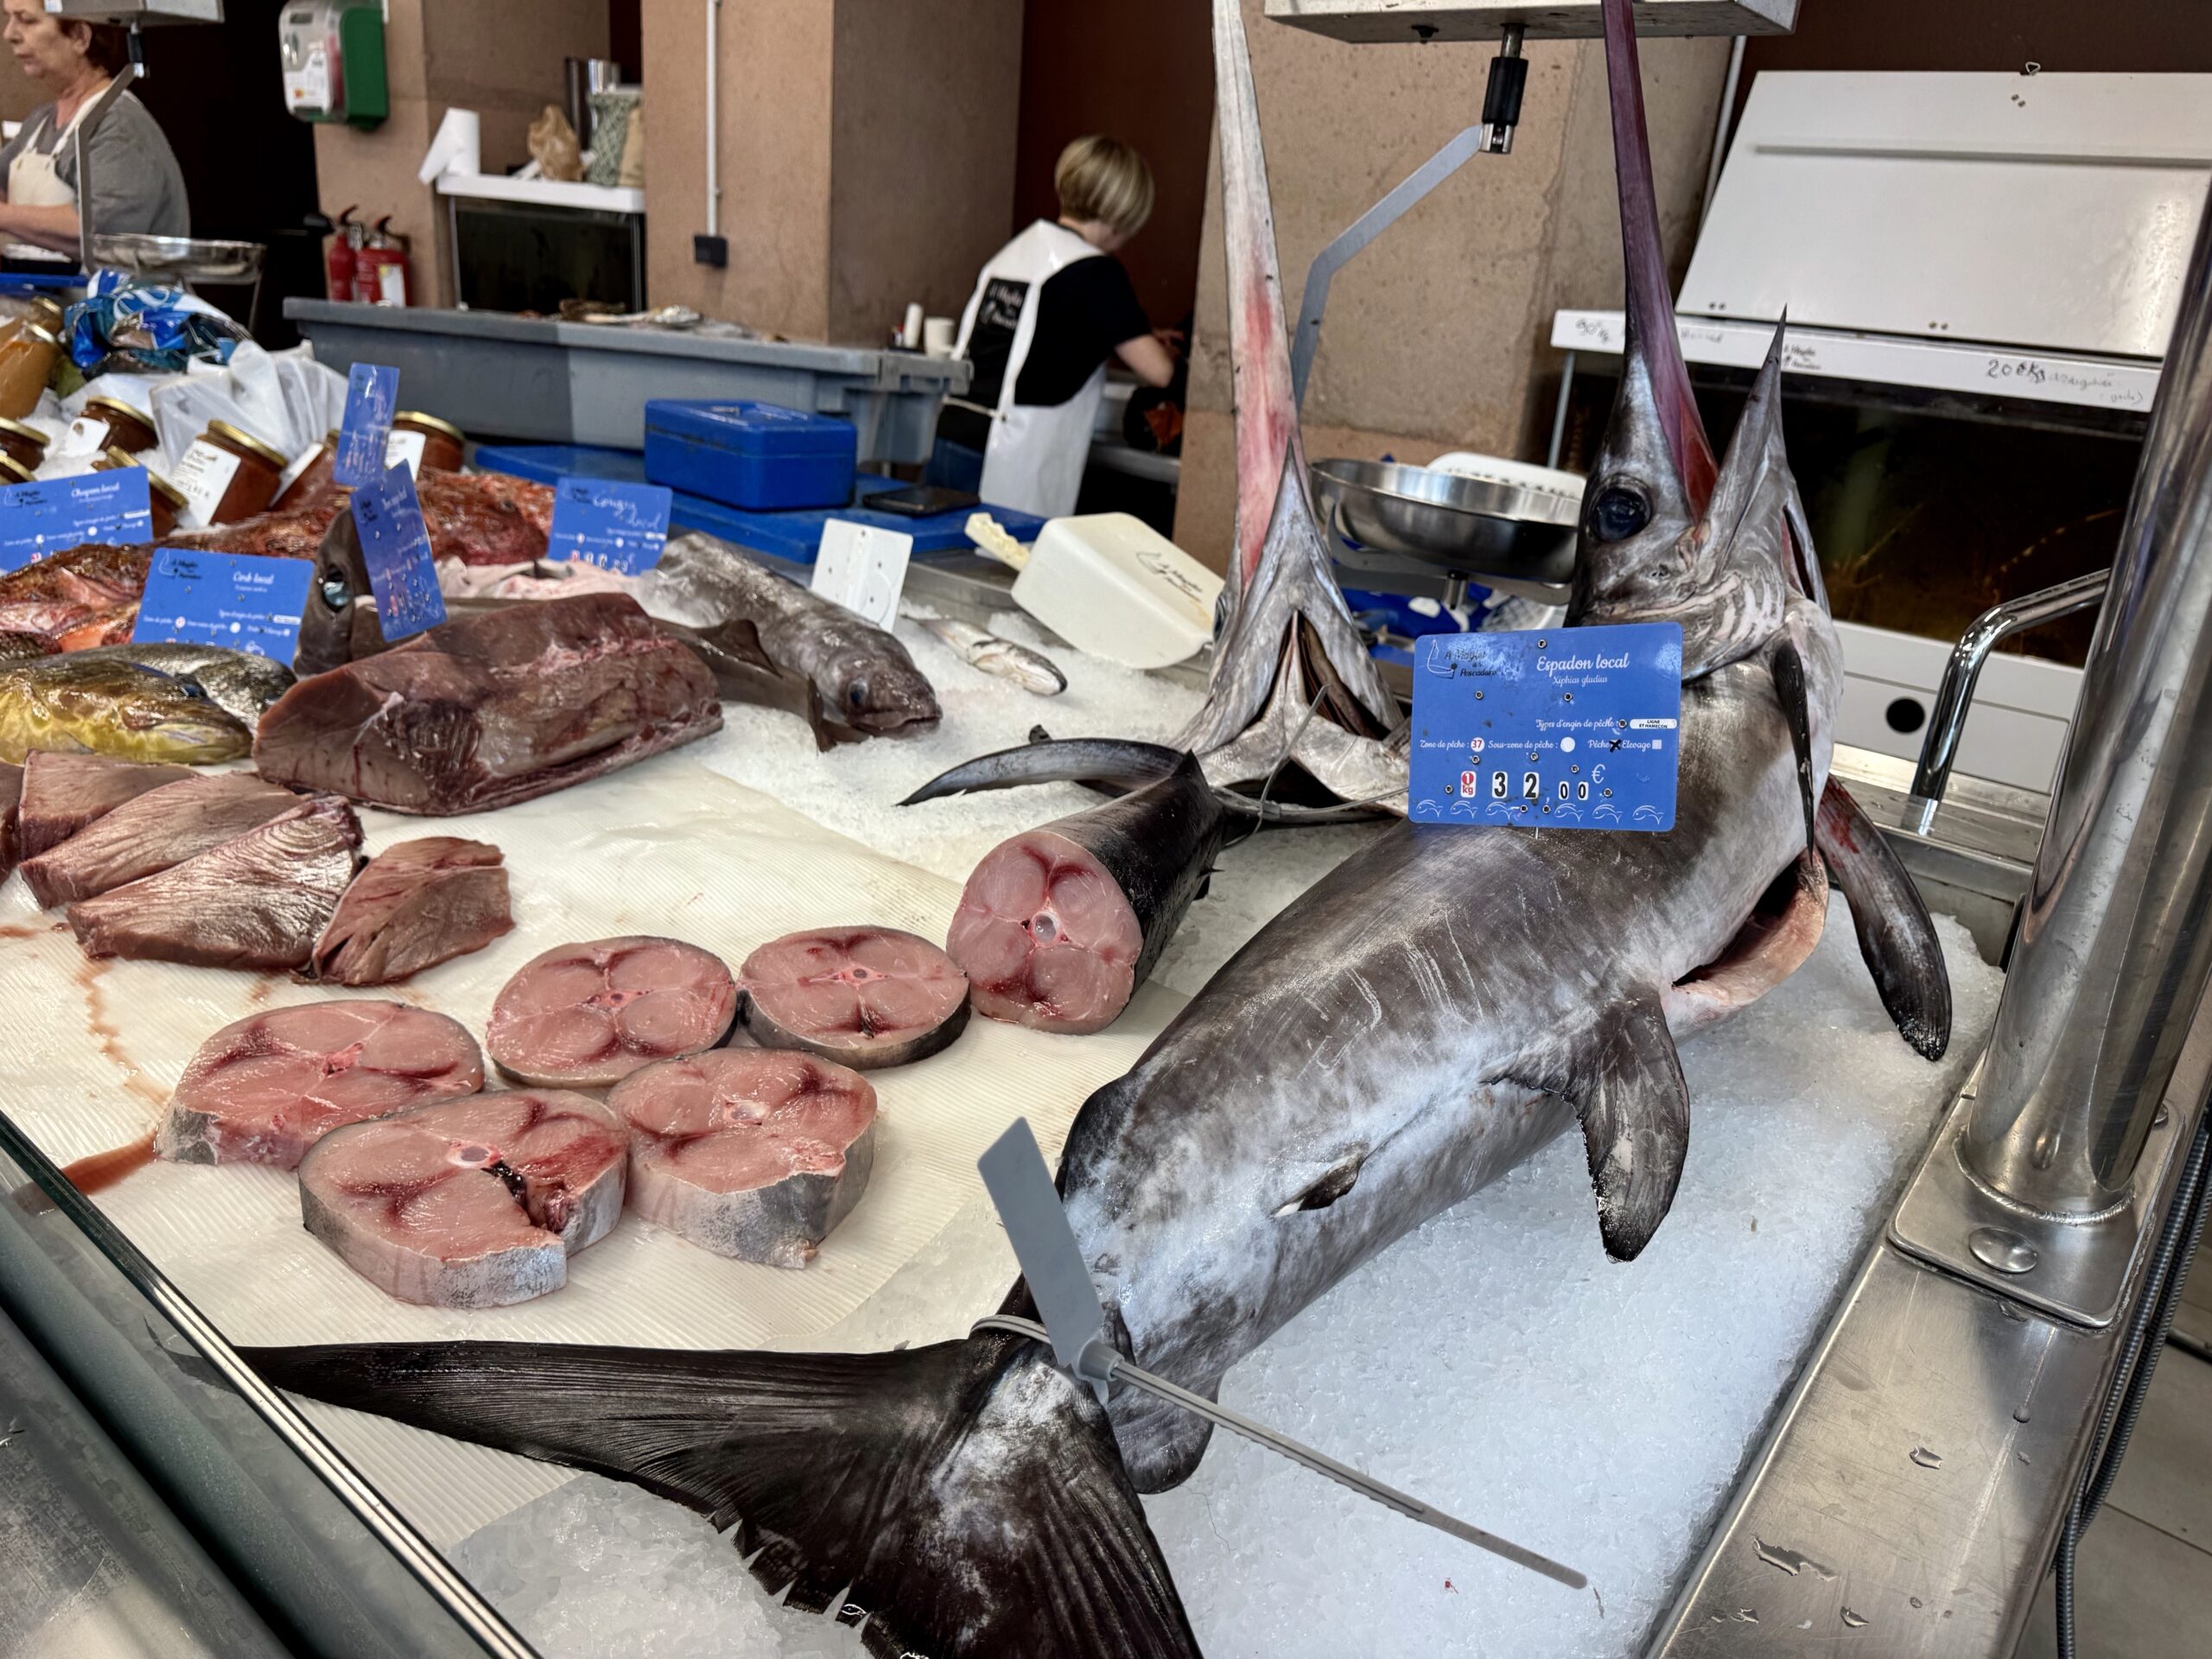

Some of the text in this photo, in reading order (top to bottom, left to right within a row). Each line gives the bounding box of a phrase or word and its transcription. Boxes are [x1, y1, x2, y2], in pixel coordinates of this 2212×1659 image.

[1536, 652, 1630, 677] Espadon local
[1553, 674, 1608, 688] Xiphias gladius
[1535, 719, 1554, 732] Types
[1556, 719, 1582, 731] d'engin
[1583, 719, 1593, 728] de
[1420, 740, 1436, 748] Zone
[1437, 740, 1446, 748] de
[1446, 740, 1465, 752] pêche
[1471, 740, 1483, 749] 37
[1488, 740, 1523, 749] Sous-zone
[1524, 740, 1533, 749] de
[1533, 740, 1554, 752] pêche
[1587, 740, 1651, 753] Pêche Elevage
[1591, 764, 1606, 784] €
[1462, 784, 1473, 796] kg
